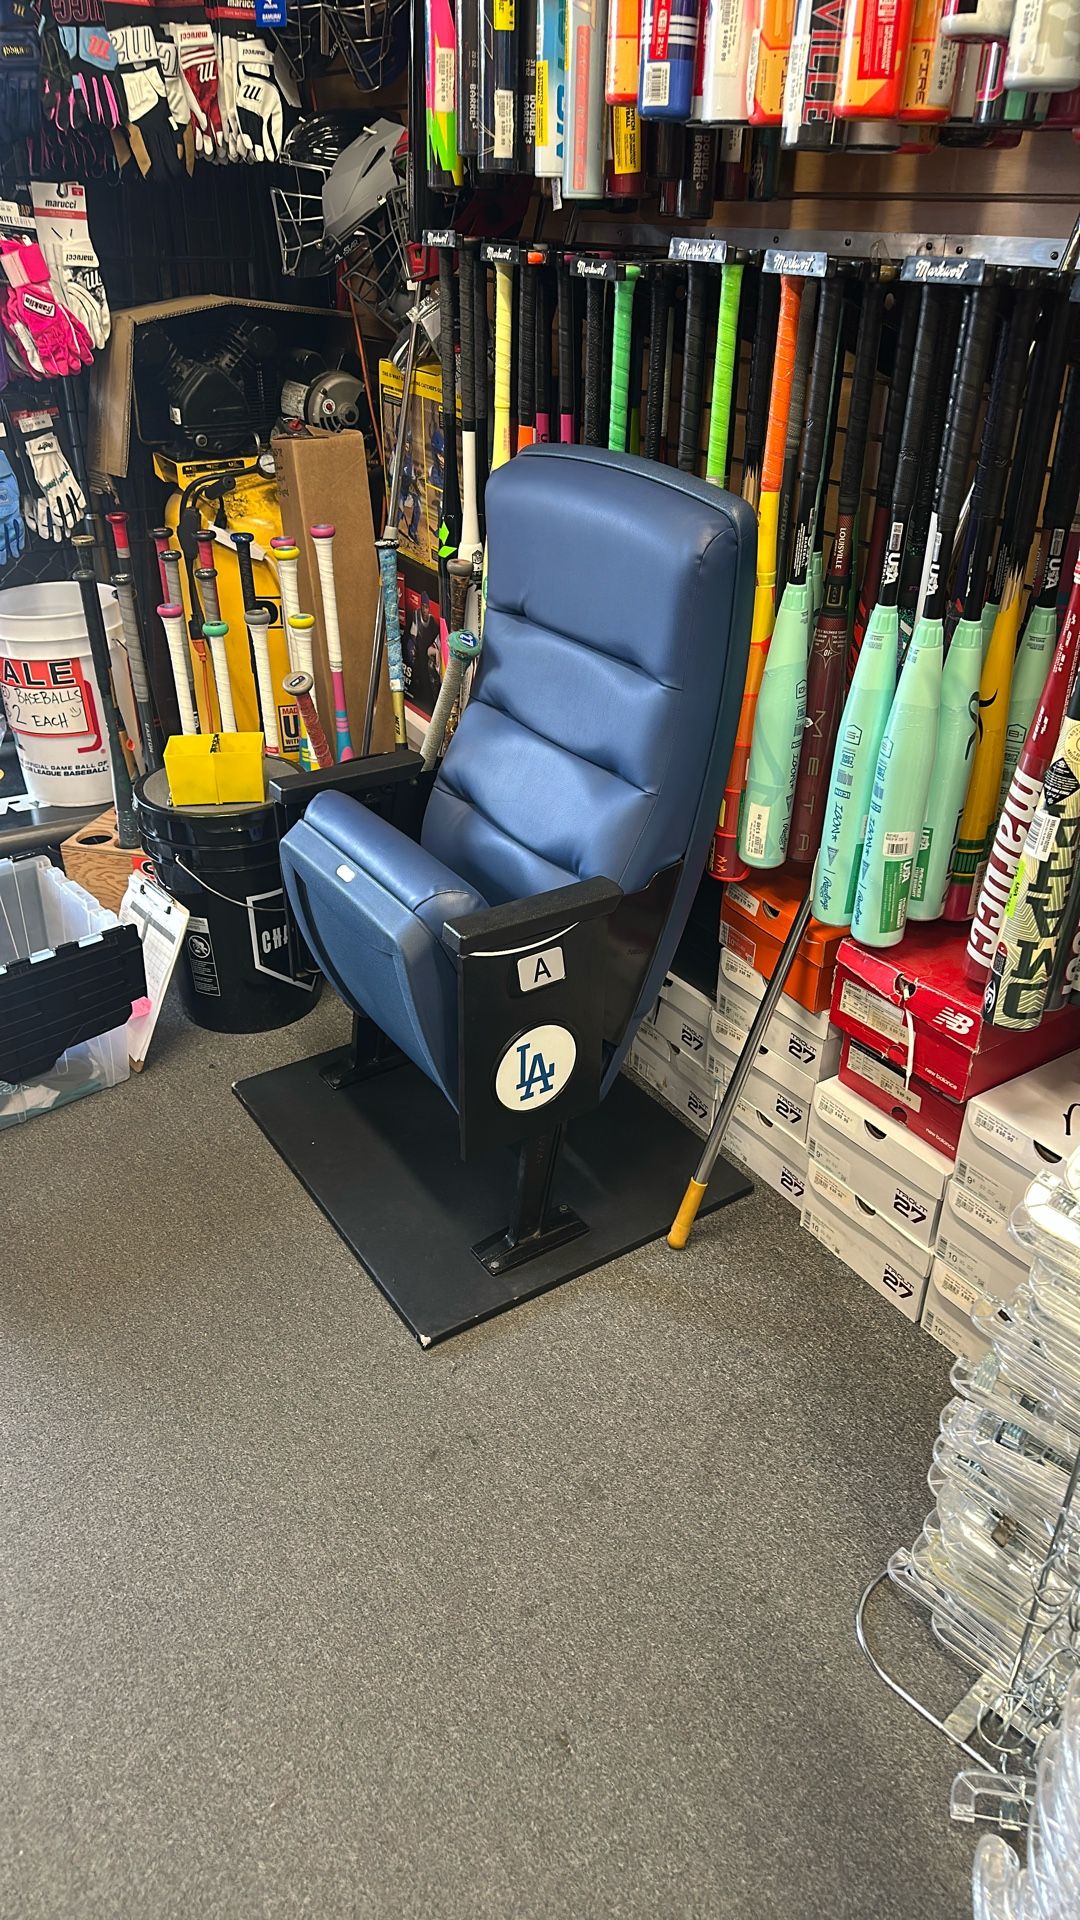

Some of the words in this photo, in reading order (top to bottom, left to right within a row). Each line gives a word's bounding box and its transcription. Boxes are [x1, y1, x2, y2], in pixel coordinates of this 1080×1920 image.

[180, 31, 208, 41] marucci
[914, 49, 930, 104] FIRE
[469, 83, 477, 122] BARREL
[522, 95, 530, 136] BARREL
[693, 135, 704, 181] BARREL
[701, 135, 711, 181] DOUBLE
[44, 199, 77, 210] marucci
[65, 253, 95, 262] marucci
[486, 246, 513, 261] Markwort
[677, 240, 715, 258] Markwort
[576, 259, 607, 276] Markwort
[773, 252, 813, 272] Markwort
[915, 258, 967, 280] Markwort
[24, 295, 54, 315] franklin
[780, 494, 790, 541] EASTON
[834, 527, 848, 570] LOUISVILLE
[15, 687, 83, 705] BASEBALLS
[33, 712, 69, 728] EACH
[144, 722, 154, 753] EASTON
[33, 768, 62, 777] LEAGUE
[63, 766, 108, 777] BASEBALL
[97, 760, 109, 768] OF
[799, 709, 827, 851] META
[966, 767, 1043, 969] marucci
[818, 876, 833, 912] Rawlings
[533, 957, 552, 983] A
[681, 1027, 703, 1051] 27
[683, 1023, 704, 1040] TROUT
[791, 1032, 817, 1052] TROUT
[788, 1038, 816, 1064] 27
[515, 1043, 555, 1102] LA
[925, 1067, 936, 1078] new
[935, 1072, 958, 1090] balance
[687, 1095, 708, 1119] 27
[690, 1090, 708, 1109] TROUT
[775, 1098, 802, 1124] 27
[777, 1093, 803, 1114] TROUT
[925, 1127, 936, 1138] new
[935, 1135, 956, 1151] balance
[780, 1170, 804, 1197] 27
[782, 1165, 805, 1187] TROUT
[893, 1193, 927, 1224] 27
[896, 1188, 928, 1213] TROUT
[948, 1252, 958, 1263] 10
[882, 1268, 913, 1299] 27
[885, 1263, 915, 1289] TROUT
